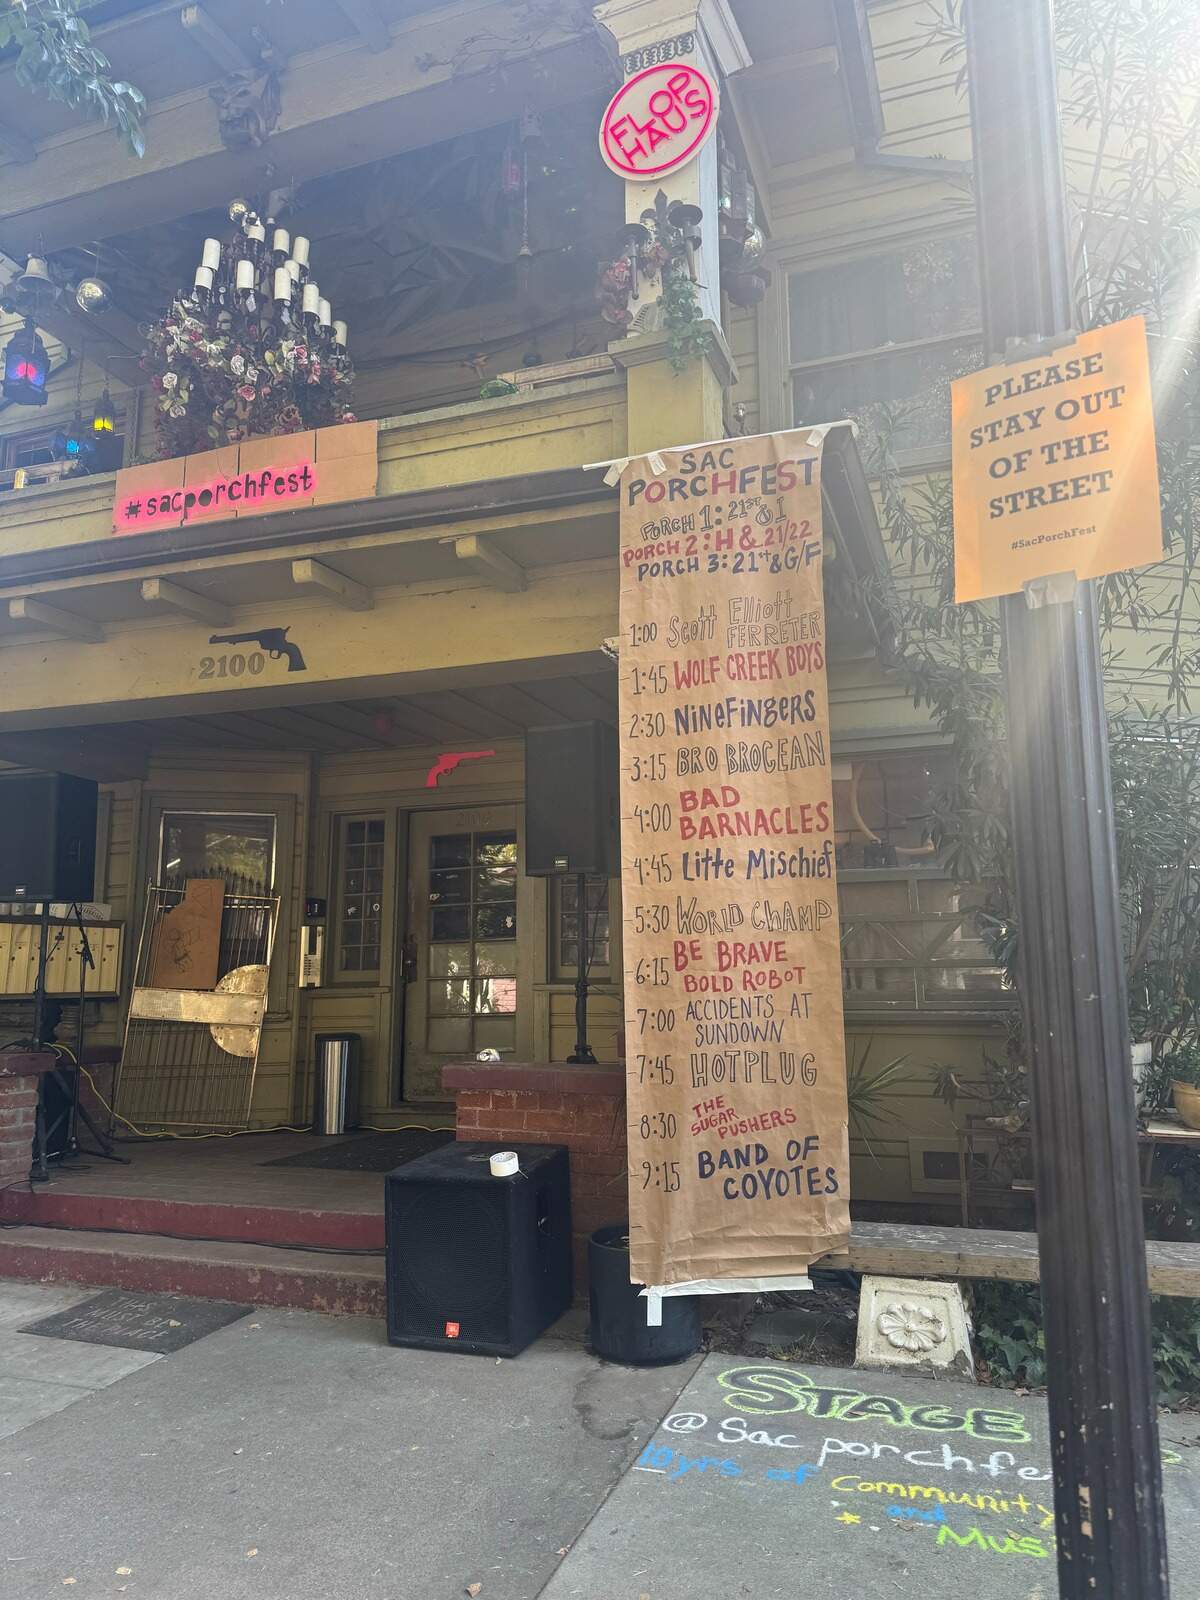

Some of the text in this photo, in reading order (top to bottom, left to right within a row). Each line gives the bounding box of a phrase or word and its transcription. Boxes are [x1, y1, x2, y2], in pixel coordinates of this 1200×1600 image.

[609, 72, 691, 150] FLOP
[621, 89, 707, 168] HAUS
[984, 352, 1104, 407] PLEASE
[970, 385, 1126, 449] STAY OUT
[680, 447, 734, 474] SAC
[988, 430, 1110, 479] OF THE
[125, 465, 313, 519] #sacporchfest
[628, 457, 818, 507] PORCHFEST
[989, 470, 1114, 519] STREET
[756, 503, 773, 526] &
[775, 496, 787, 523] I
[622, 519, 812, 568] PORCH 2: H & 21/22
[1011, 525, 1097, 550] #SacPorchFest
[637, 557, 699, 581] PORCH
[707, 553, 728, 573] 3:
[769, 553, 782, 574] &
[784, 540, 822, 576] G/F
[629, 591, 793, 648] 1:00 Scott Elliott
[727, 610, 822, 648] FERRETER
[198, 652, 265, 680] 2100
[632, 641, 824, 695] 1:45 WOLF CREEK BOYS
[629, 712, 665, 738] 2:30
[630, 731, 826, 782] 3:15 BRO BROCEAN
[679, 785, 741, 812] BAD
[634, 801, 830, 841] 4:00 BARNACLES
[634, 853, 672, 885] 4:45
[746, 840, 833, 881] Mischief
[635, 905, 670, 934] 5:30
[676, 896, 744, 935] WORLD
[636, 957, 670, 986] 6:15
[683, 974, 733, 993] BOLD
[673, 939, 788, 972] BE BRAVE
[637, 993, 813, 1035] 7:00 ACCIDENTS AT
[695, 1019, 785, 1047] SUNDOWN
[636, 1050, 818, 1088] 7:45 HOTPLUG
[640, 1107, 740, 1139] 8:30 SUGAR
[692, 1095, 725, 1118] THE
[718, 1108, 798, 1140] PUSHERS
[697, 1135, 820, 1179] BAND OF
[642, 1161, 839, 1200] 9:15 COYOTES
[662, 1412, 708, 1434] @
[717, 1417, 805, 1448] Sac
[831, 1475, 1055, 1531] Community
